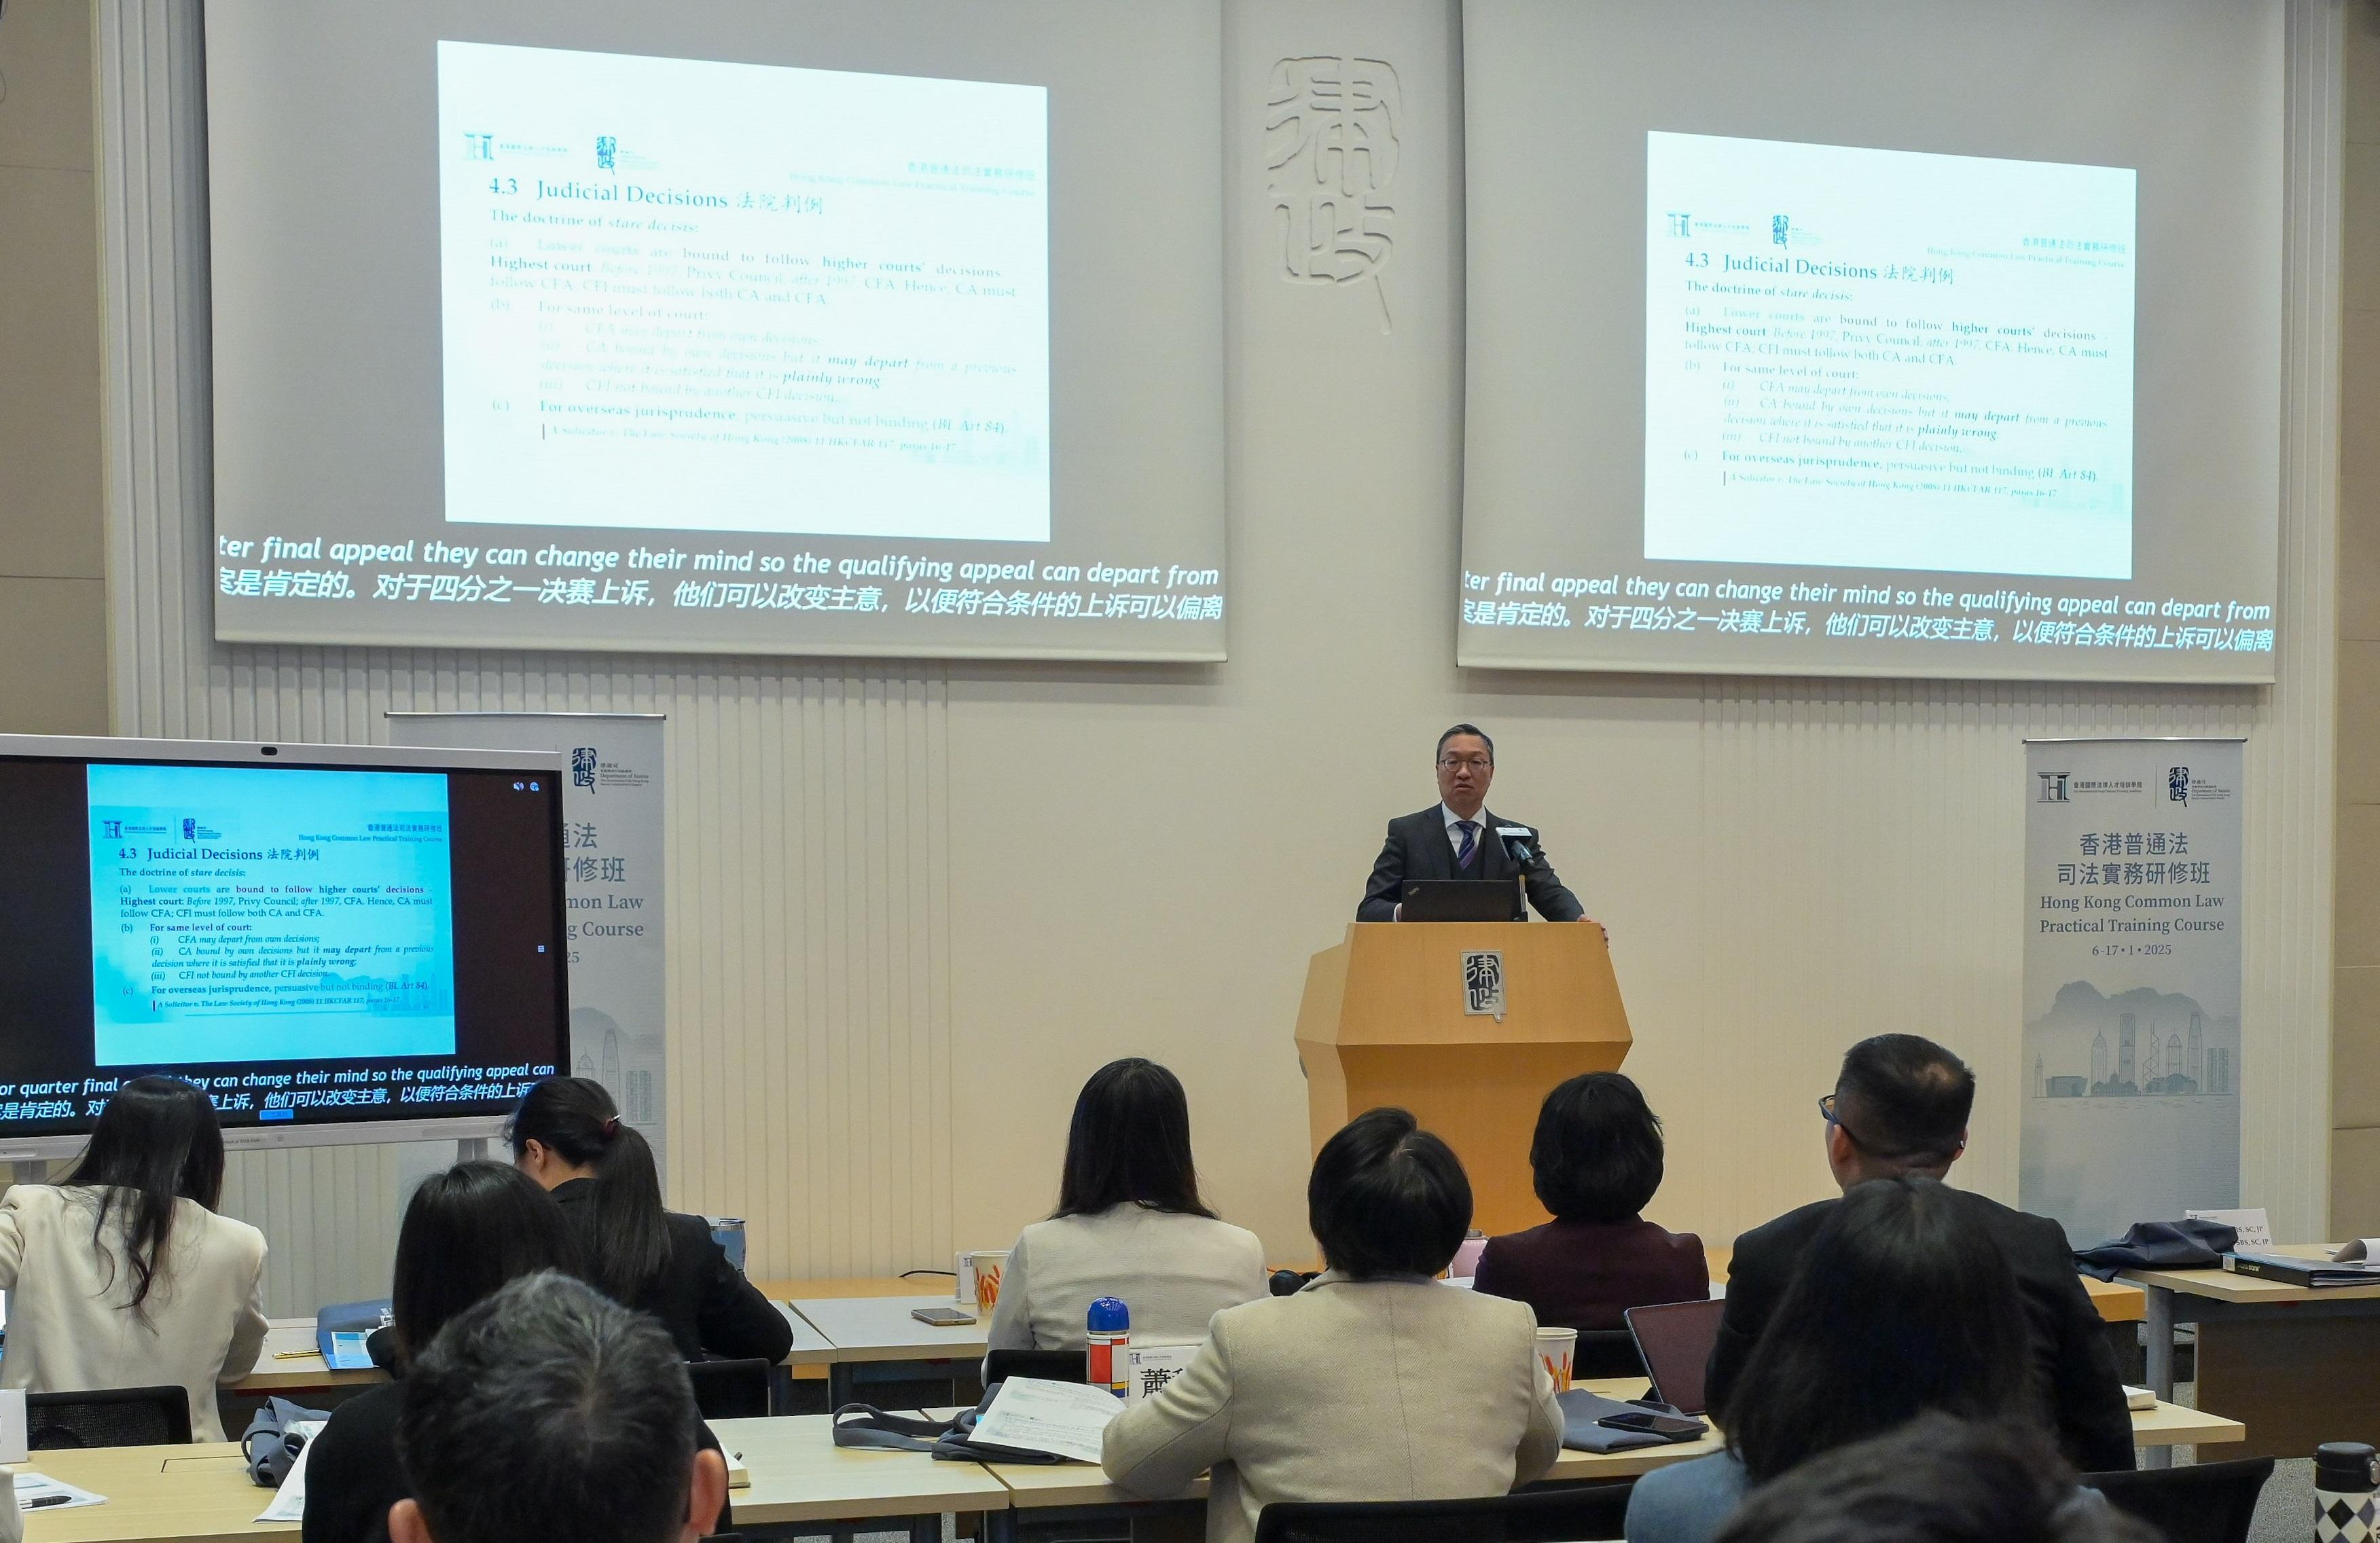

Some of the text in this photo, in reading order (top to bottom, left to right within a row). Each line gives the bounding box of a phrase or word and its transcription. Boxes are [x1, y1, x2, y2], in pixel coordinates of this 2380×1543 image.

[488, 176, 520, 196] 4.3
[536, 178, 619, 201] Judicial
[626, 184, 729, 208] Decisions
[1684, 251, 1953, 285] 4.3 Judicial Decisions 法院判例
[1684, 279, 1853, 302] The doctrine of stare decisis:
[260, 536, 321, 564] final
[329, 539, 414, 566] appeal
[423, 540, 479, 568] they
[485, 548, 527, 565] can
[535, 543, 619, 573] change
[628, 546, 687, 570] their
[693, 549, 754, 571] mind
[759, 556, 785, 573] so
[793, 551, 831, 574] the
[838, 554, 953, 583] qualifying
[959, 559, 1035, 584] appeal
[1042, 565, 1080, 581] can
[1087, 562, 1161, 587] depart
[1166, 564, 1219, 589] from
[1494, 571, 1545, 596] final
[1551, 575, 1619, 598] appeal
[1625, 575, 1670, 600] they
[1675, 582, 1710, 598] can
[1715, 579, 1783, 604] change
[1790, 581, 1837, 602] their
[1842, 584, 1891, 604] mind
[1895, 590, 1916, 605] so
[1922, 587, 1954, 606] the
[1959, 589, 2052, 615] qualifying
[2057, 595, 2119, 617] appeal
[2125, 600, 2156, 615] can
[2161, 597, 2221, 621] depart
[2225, 600, 2270, 623] from
[2079, 832, 2189, 856] 香港普通法
[118, 848, 319, 862] 4.3 Judicial Decisions 法院判例
[118, 867, 137, 876] The
[139, 867, 177, 876] doctrine
[179, 868, 189, 876] of
[214, 868, 246, 877] decisis:
[2057, 862, 2211, 886] 司法實務研修班
[120, 884, 132, 895] (a)
[148, 884, 178, 894] Lower
[236, 884, 264, 893] bound
[285, 885, 312, 893] follow
[319, 885, 346, 895] higher
[352, 885, 380, 894] courts'
[386, 885, 424, 894] decisions
[120, 896, 156, 907] Highest
[187, 896, 211, 907] Before
[214, 896, 236, 906] 1997,
[238, 896, 261, 907] Privy
[264, 896, 298, 906] Council;
[300, 896, 319, 907] after
[321, 896, 342, 906] 1997,
[344, 896, 365, 905] CFA.
[367, 896, 395, 906] Hence,
[397, 896, 411, 905] CA
[608, 894, 644, 909] Law
[2040, 894, 2224, 912] Hong Kong Common Law
[120, 909, 148, 918] follow
[151, 909, 174, 918] CFA;
[175, 909, 192, 917] CFI
[218, 909, 245, 917] follow
[247, 909, 266, 917] both
[268, 909, 283, 917] CA
[285, 909, 301, 917] and
[302, 909, 325, 917] CFA.
[120, 923, 133, 934] (b)
[149, 923, 164, 932] For
[192, 923, 213, 931] level
[215, 923, 226, 931] of
[581, 921, 645, 937] Course
[2040, 918, 2224, 935] Practical Training Course
[121, 985, 135, 998] (c)
[151, 985, 166, 994] For
[208, 984, 272, 996] jurisprudence,
[274, 983, 319, 995] persuasive
[320, 981, 334, 991] but
[336, 983, 350, 991] not
[352, 981, 383, 992] binding
[385, 981, 399, 992] (BL
[400, 981, 414, 990] Art
[415, 981, 429, 991] 84).
[20, 1081, 79, 1098] quarter
[82, 1077, 118, 1095] final
[213, 1076, 238, 1087] can
[242, 1072, 291, 1088] change
[296, 1070, 331, 1085] their
[333, 1068, 369, 1083] mind
[372, 1071, 387, 1081] so
[391, 1067, 413, 1081] the
[416, 1065, 483, 1083] qualifying
[486, 1062, 529, 1080] appeal
[533, 1065, 554, 1075] can
